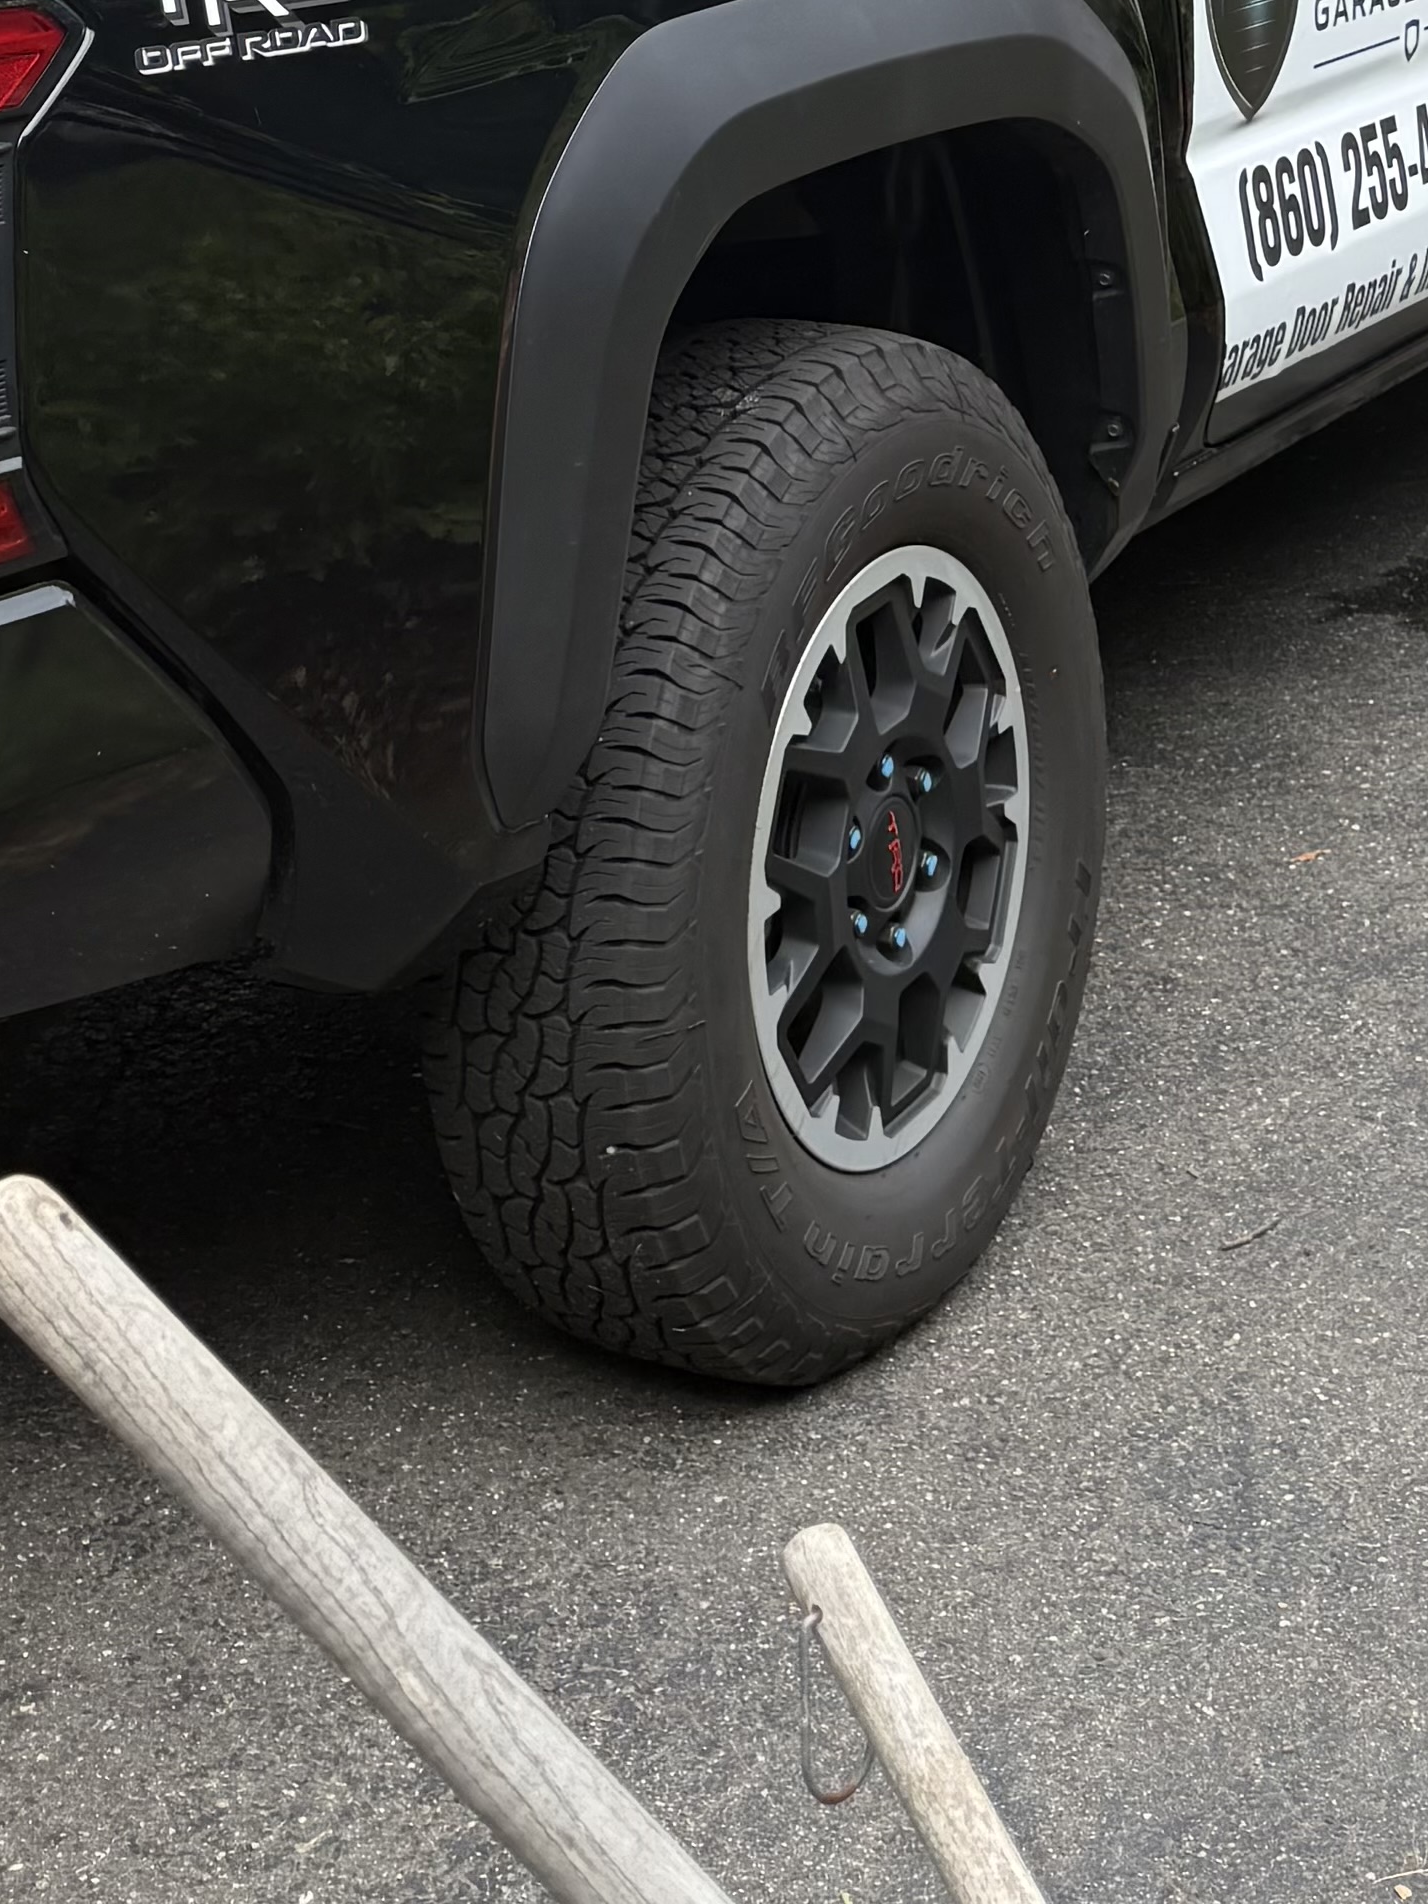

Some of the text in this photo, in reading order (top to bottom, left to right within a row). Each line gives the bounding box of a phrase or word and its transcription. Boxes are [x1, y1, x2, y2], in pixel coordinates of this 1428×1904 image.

[134, 15, 369, 76] OFF ROAD
[1238, 141, 1340, 282] (860)
[1219, 321, 1287, 391] arage
[1285, 296, 1339, 359] Door
[1334, 259, 1403, 334] Repair
[1399, 253, 1418, 302] &
